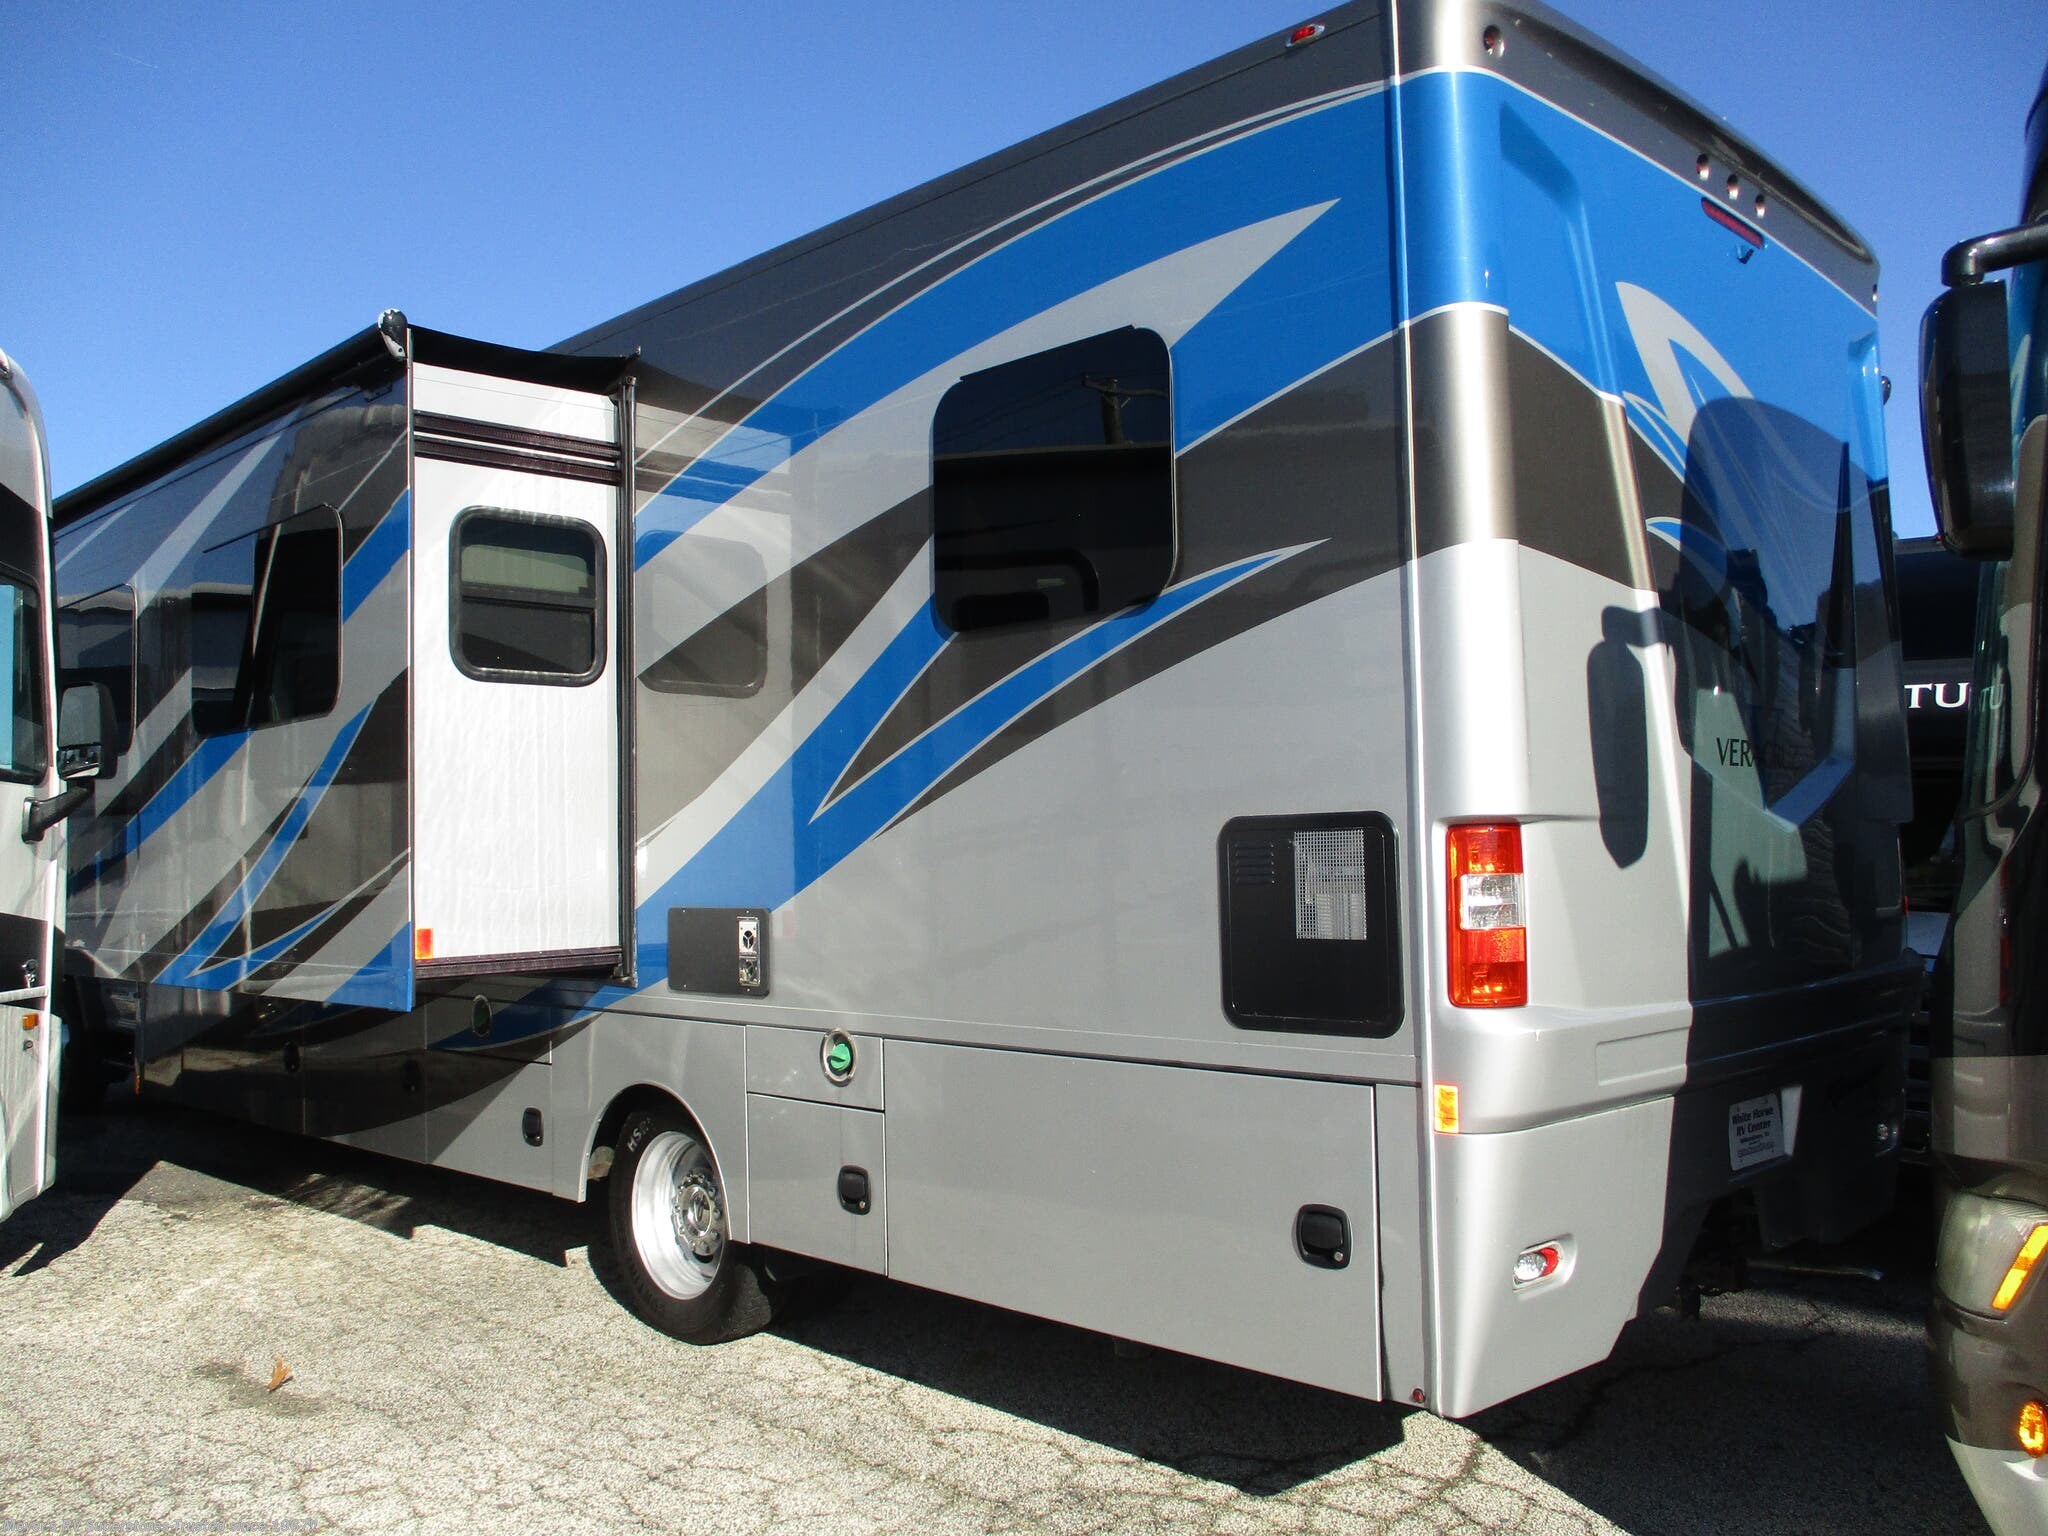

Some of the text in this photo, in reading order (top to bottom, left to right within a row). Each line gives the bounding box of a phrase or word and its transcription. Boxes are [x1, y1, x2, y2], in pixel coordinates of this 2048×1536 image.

[1904, 681, 1971, 709] TU
[1716, 737, 1756, 767] VER
[1736, 1125, 1746, 1136] RV
